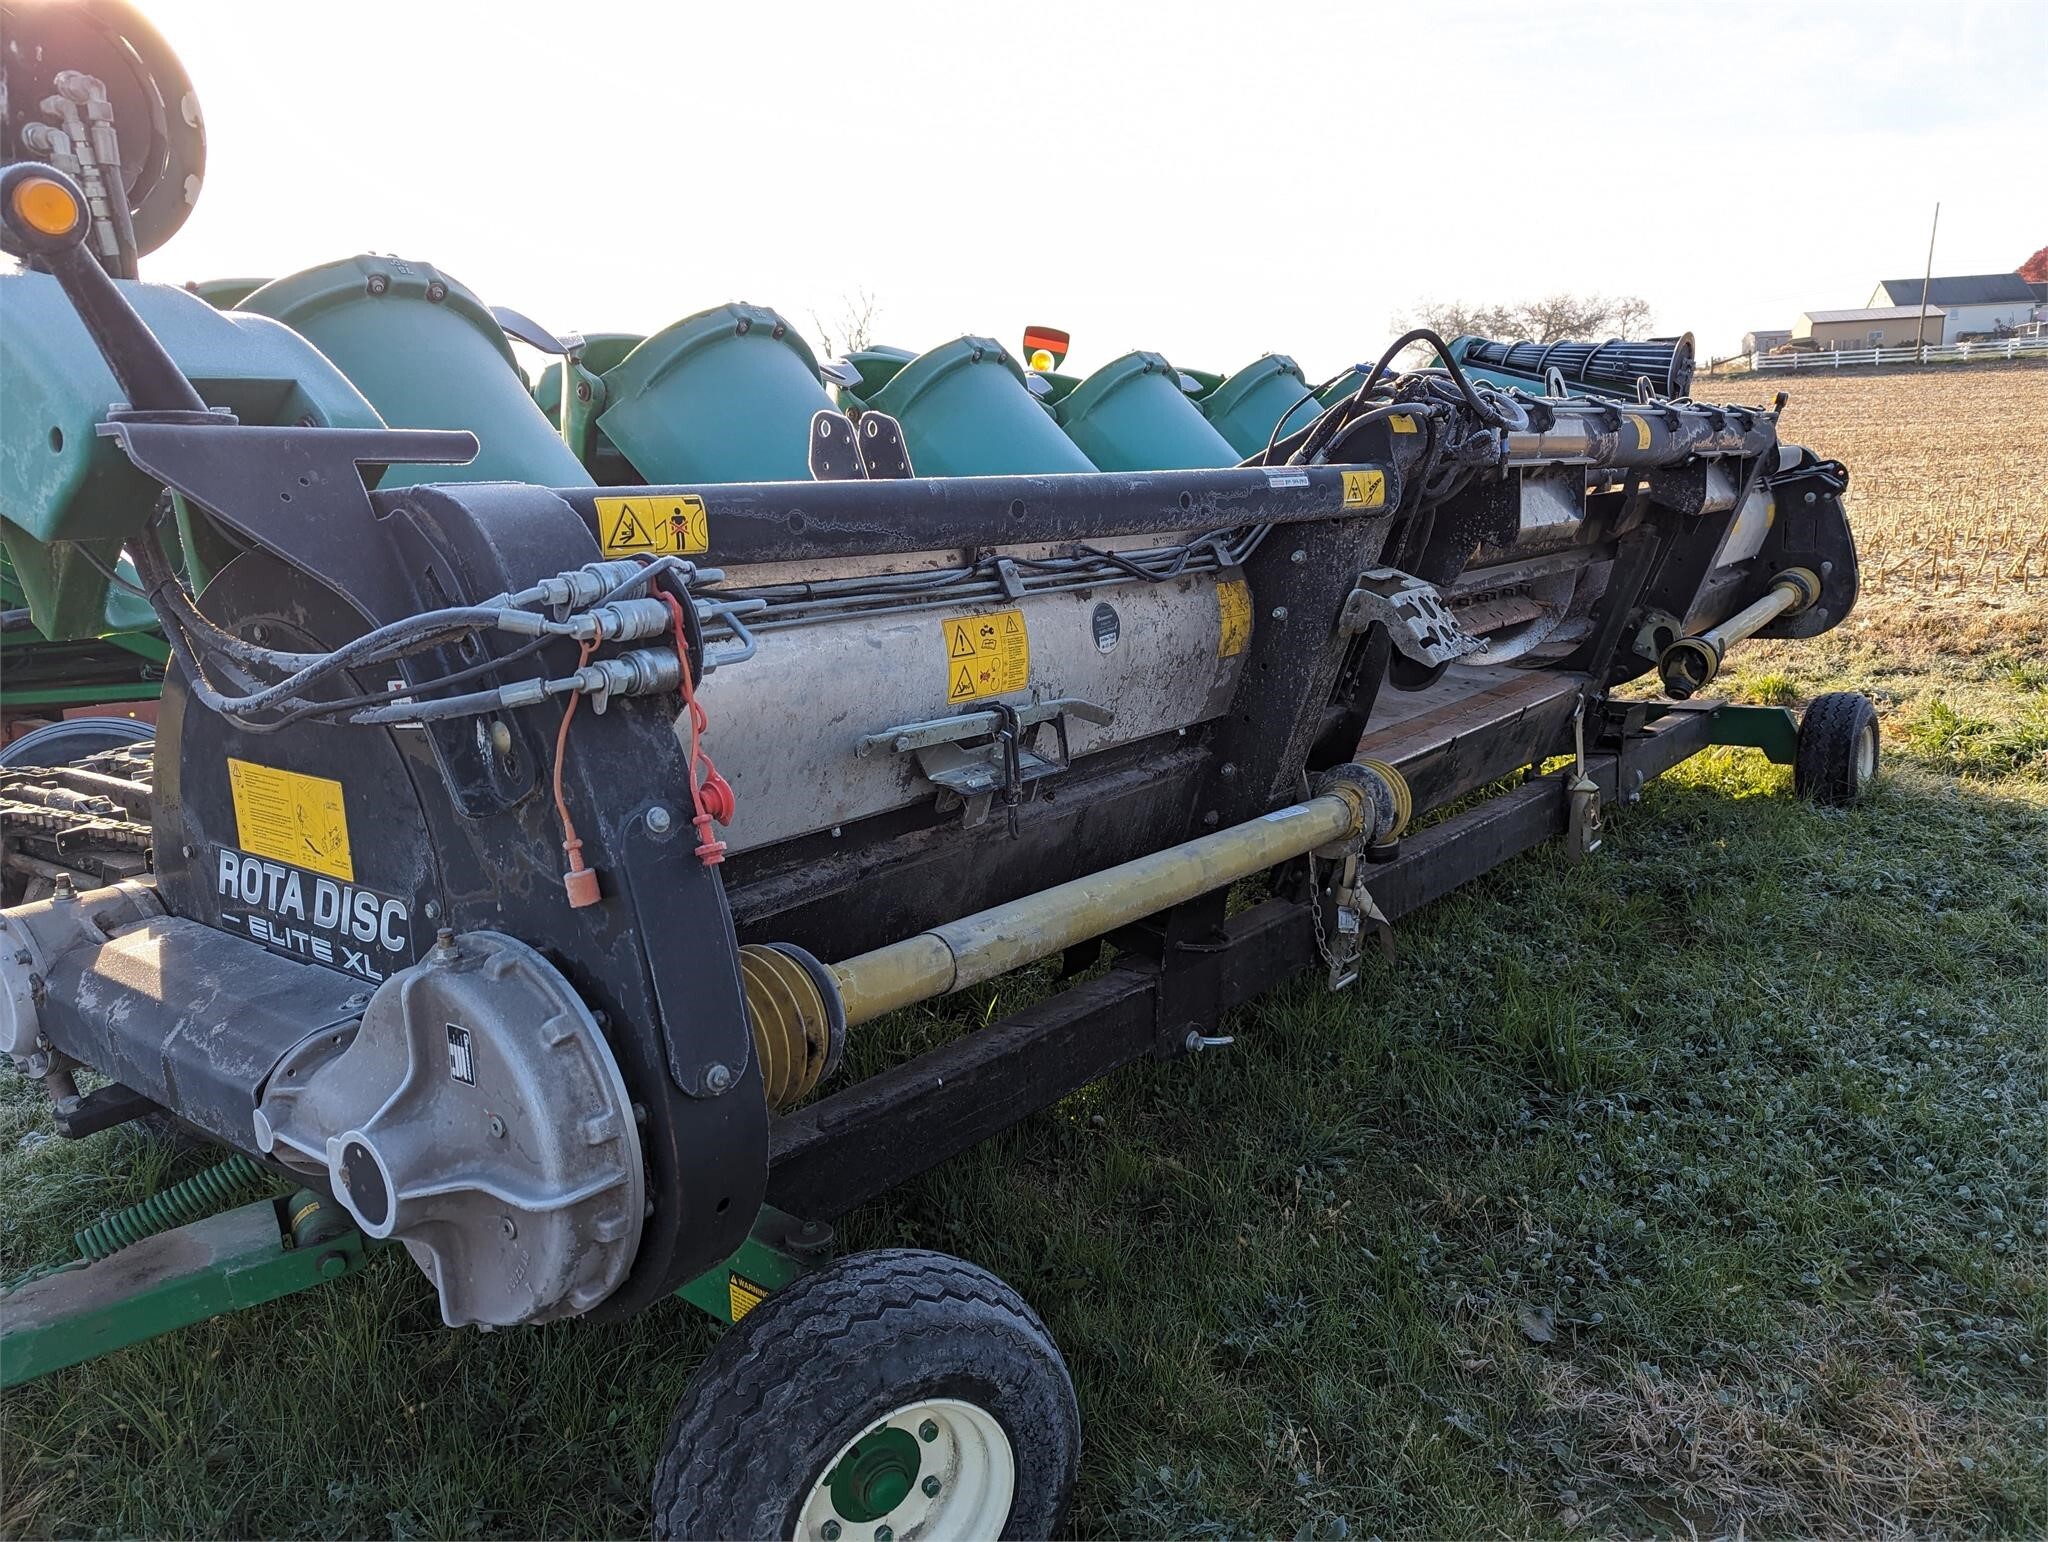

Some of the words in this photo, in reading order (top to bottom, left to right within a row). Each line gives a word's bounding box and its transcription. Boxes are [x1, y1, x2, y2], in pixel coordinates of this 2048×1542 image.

[219, 849, 305, 921] ROTA
[313, 878, 408, 952] DISC
[248, 914, 333, 963] ELITE
[341, 946, 383, 981] XL
